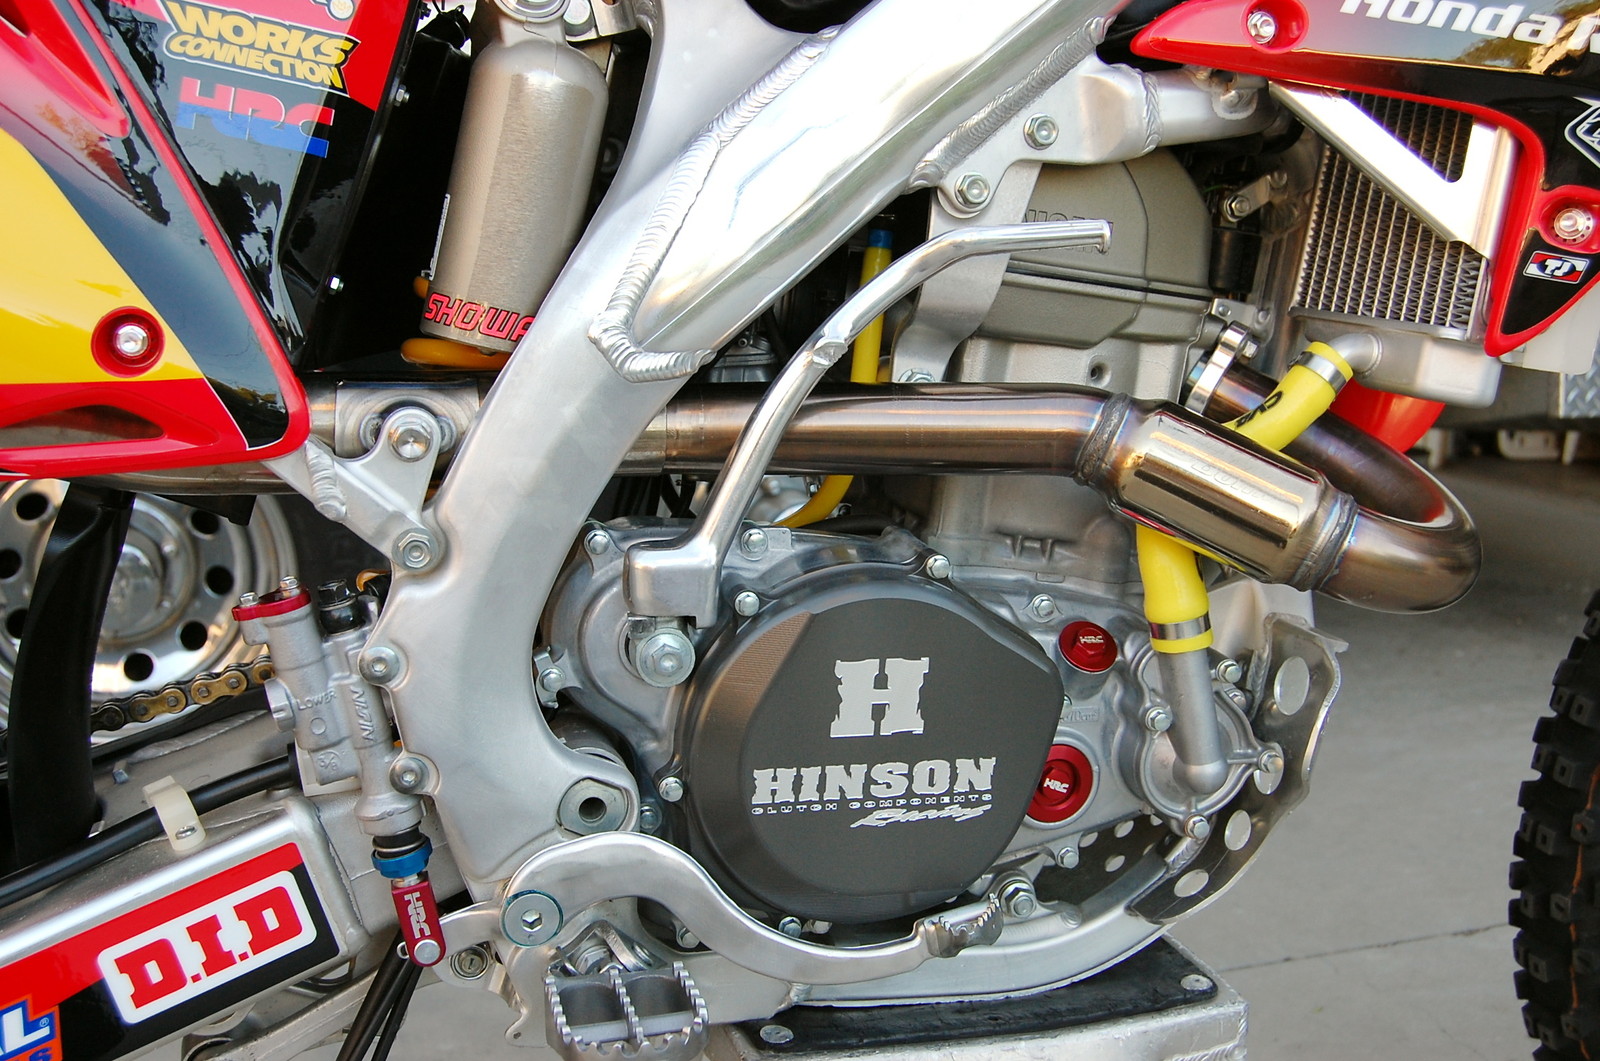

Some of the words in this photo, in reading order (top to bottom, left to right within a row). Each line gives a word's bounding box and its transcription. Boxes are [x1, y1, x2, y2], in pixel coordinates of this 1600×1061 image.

[167, 2, 353, 65] WORKS
[169, 34, 343, 89] CONNECTION
[174, 76, 335, 158] HRC
[1079, 635, 1104, 644] HRC
[830, 657, 929, 738] H
[752, 757, 996, 804] HINSON
[752, 803, 838, 815] CLUTCH
[849, 793, 992, 809] COMPONENTS
[1043, 778, 1070, 793] HRC
[404, 891, 431, 939] HRC
